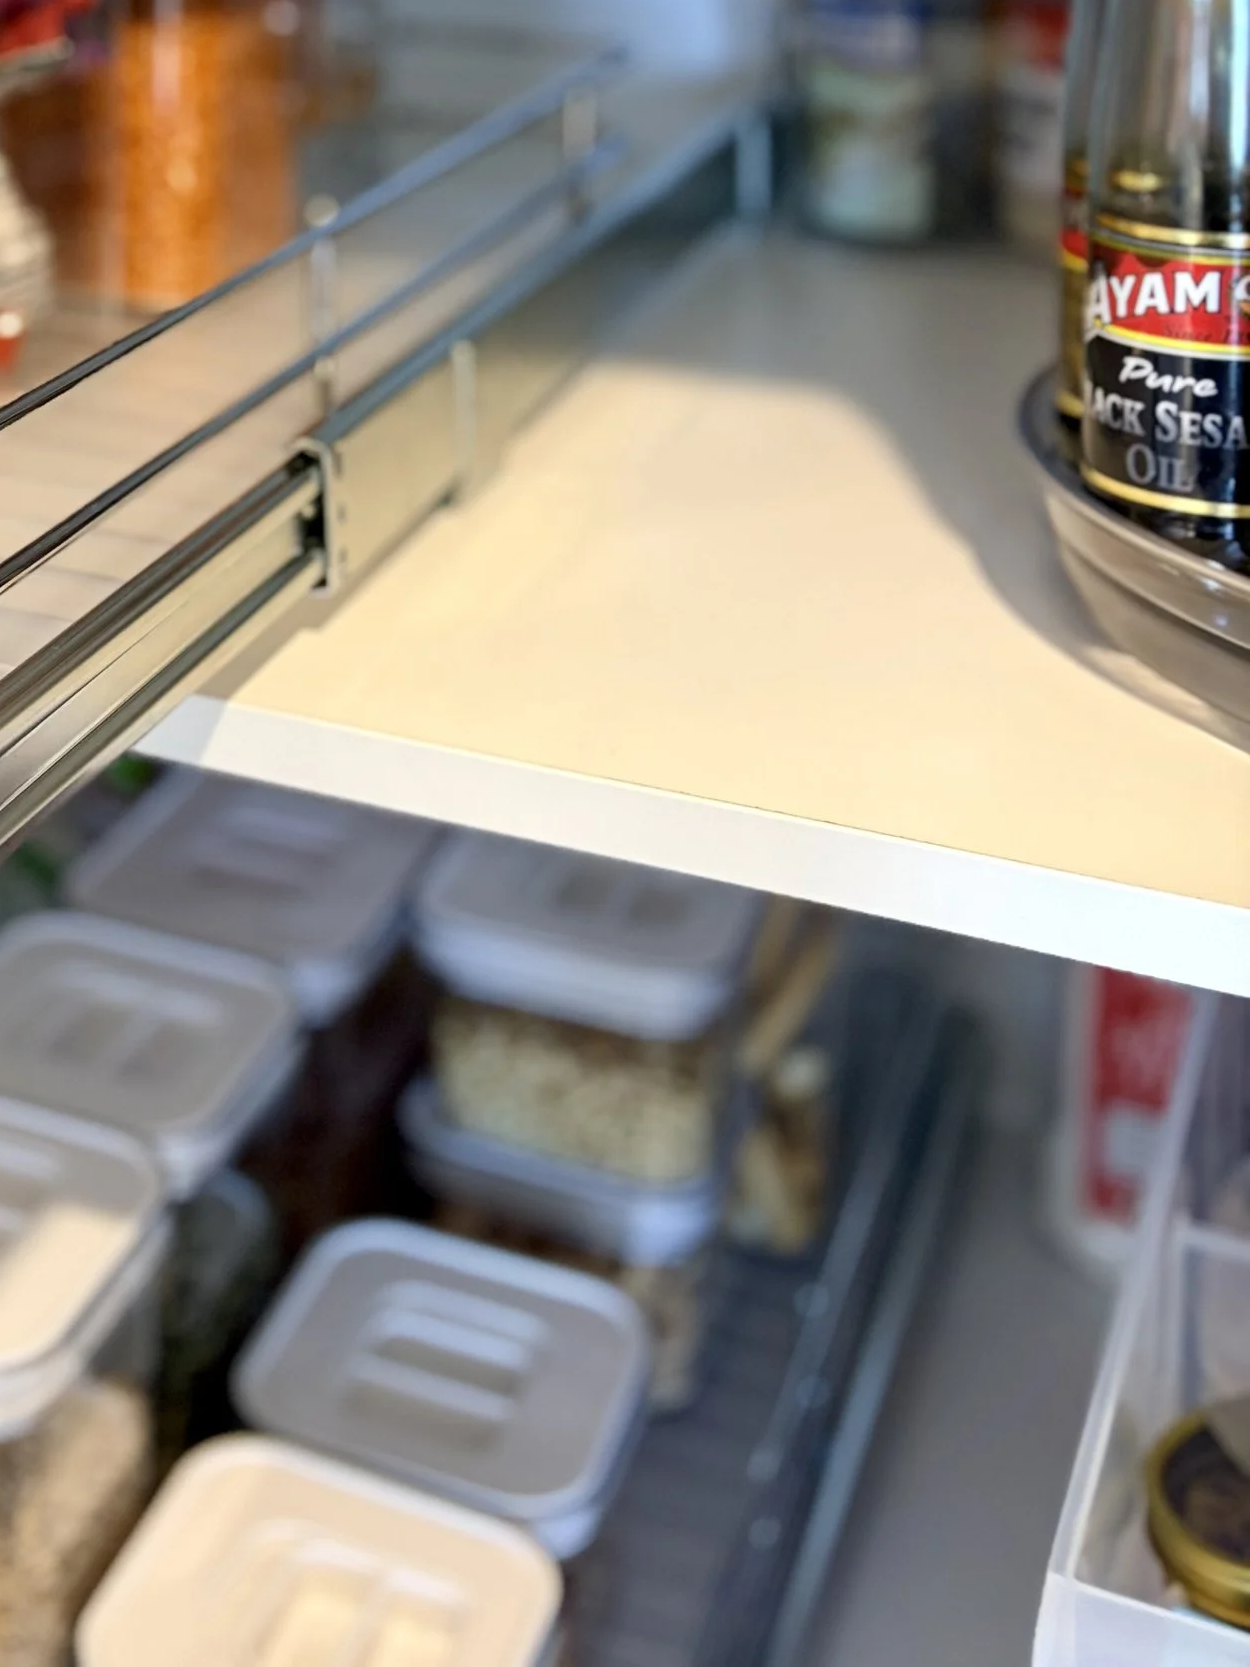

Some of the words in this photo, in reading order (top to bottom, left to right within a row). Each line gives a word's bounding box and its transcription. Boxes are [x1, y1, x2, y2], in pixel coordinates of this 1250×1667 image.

[1086, 261, 1222, 327] AYAM
[1118, 355, 1218, 397] Pure
[1087, 385, 1146, 437] ACK
